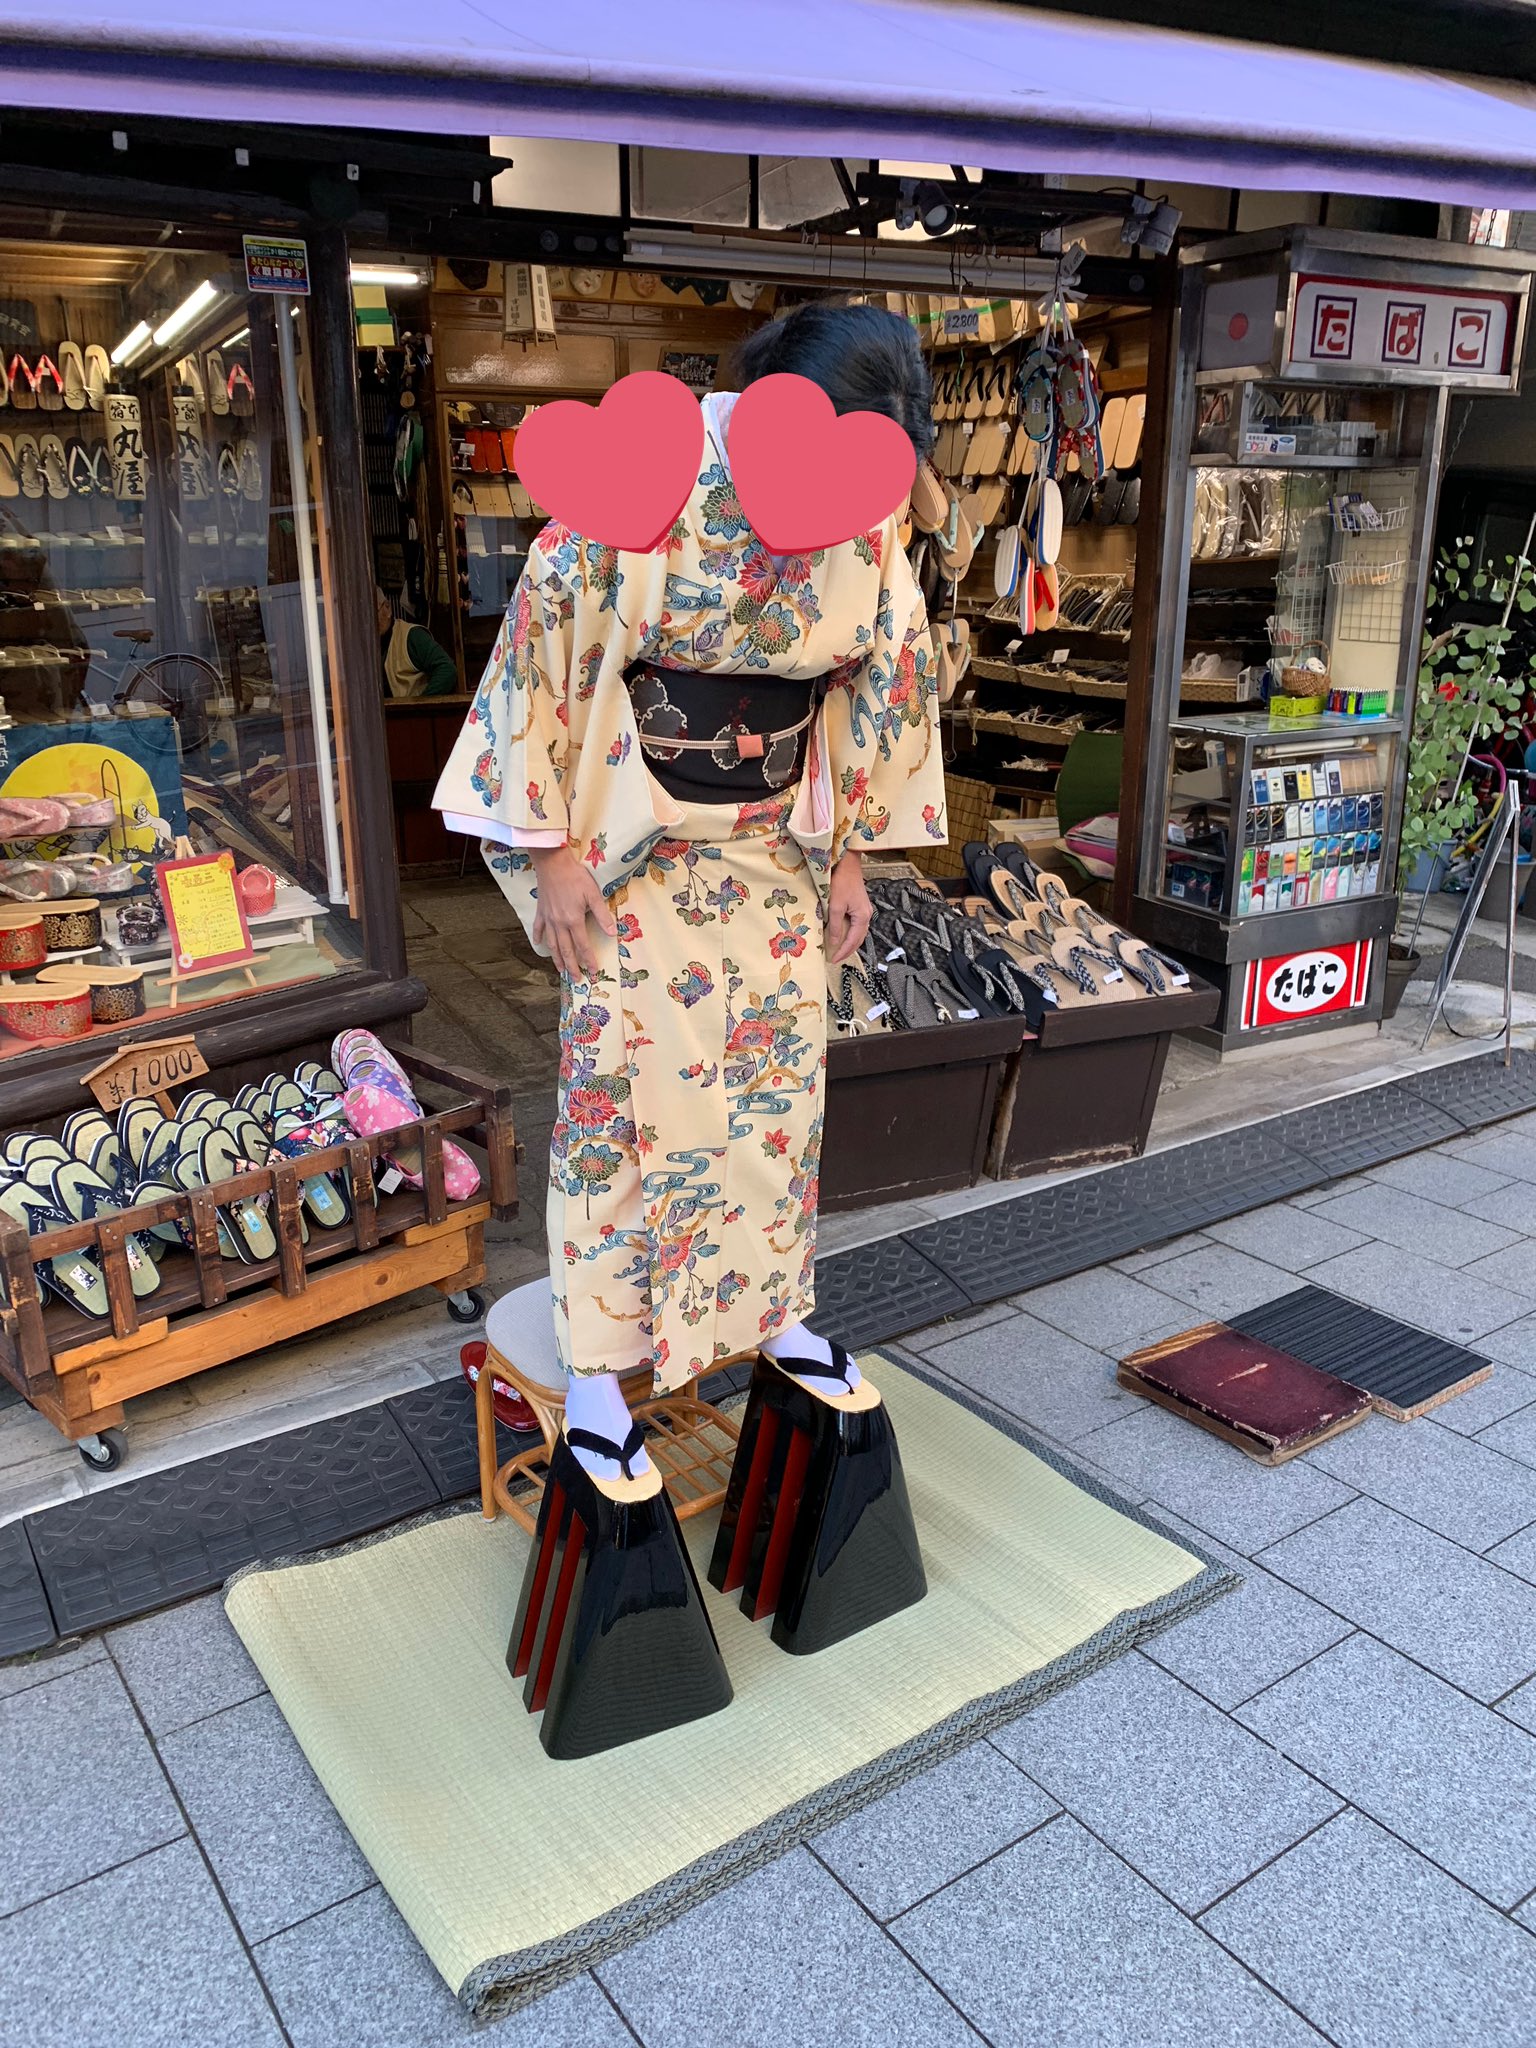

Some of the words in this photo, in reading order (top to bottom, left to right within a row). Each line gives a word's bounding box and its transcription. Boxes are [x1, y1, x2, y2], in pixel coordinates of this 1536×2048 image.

[1317, 303, 1485, 361] たばこ
[1273, 960, 1339, 1003] たばこ
